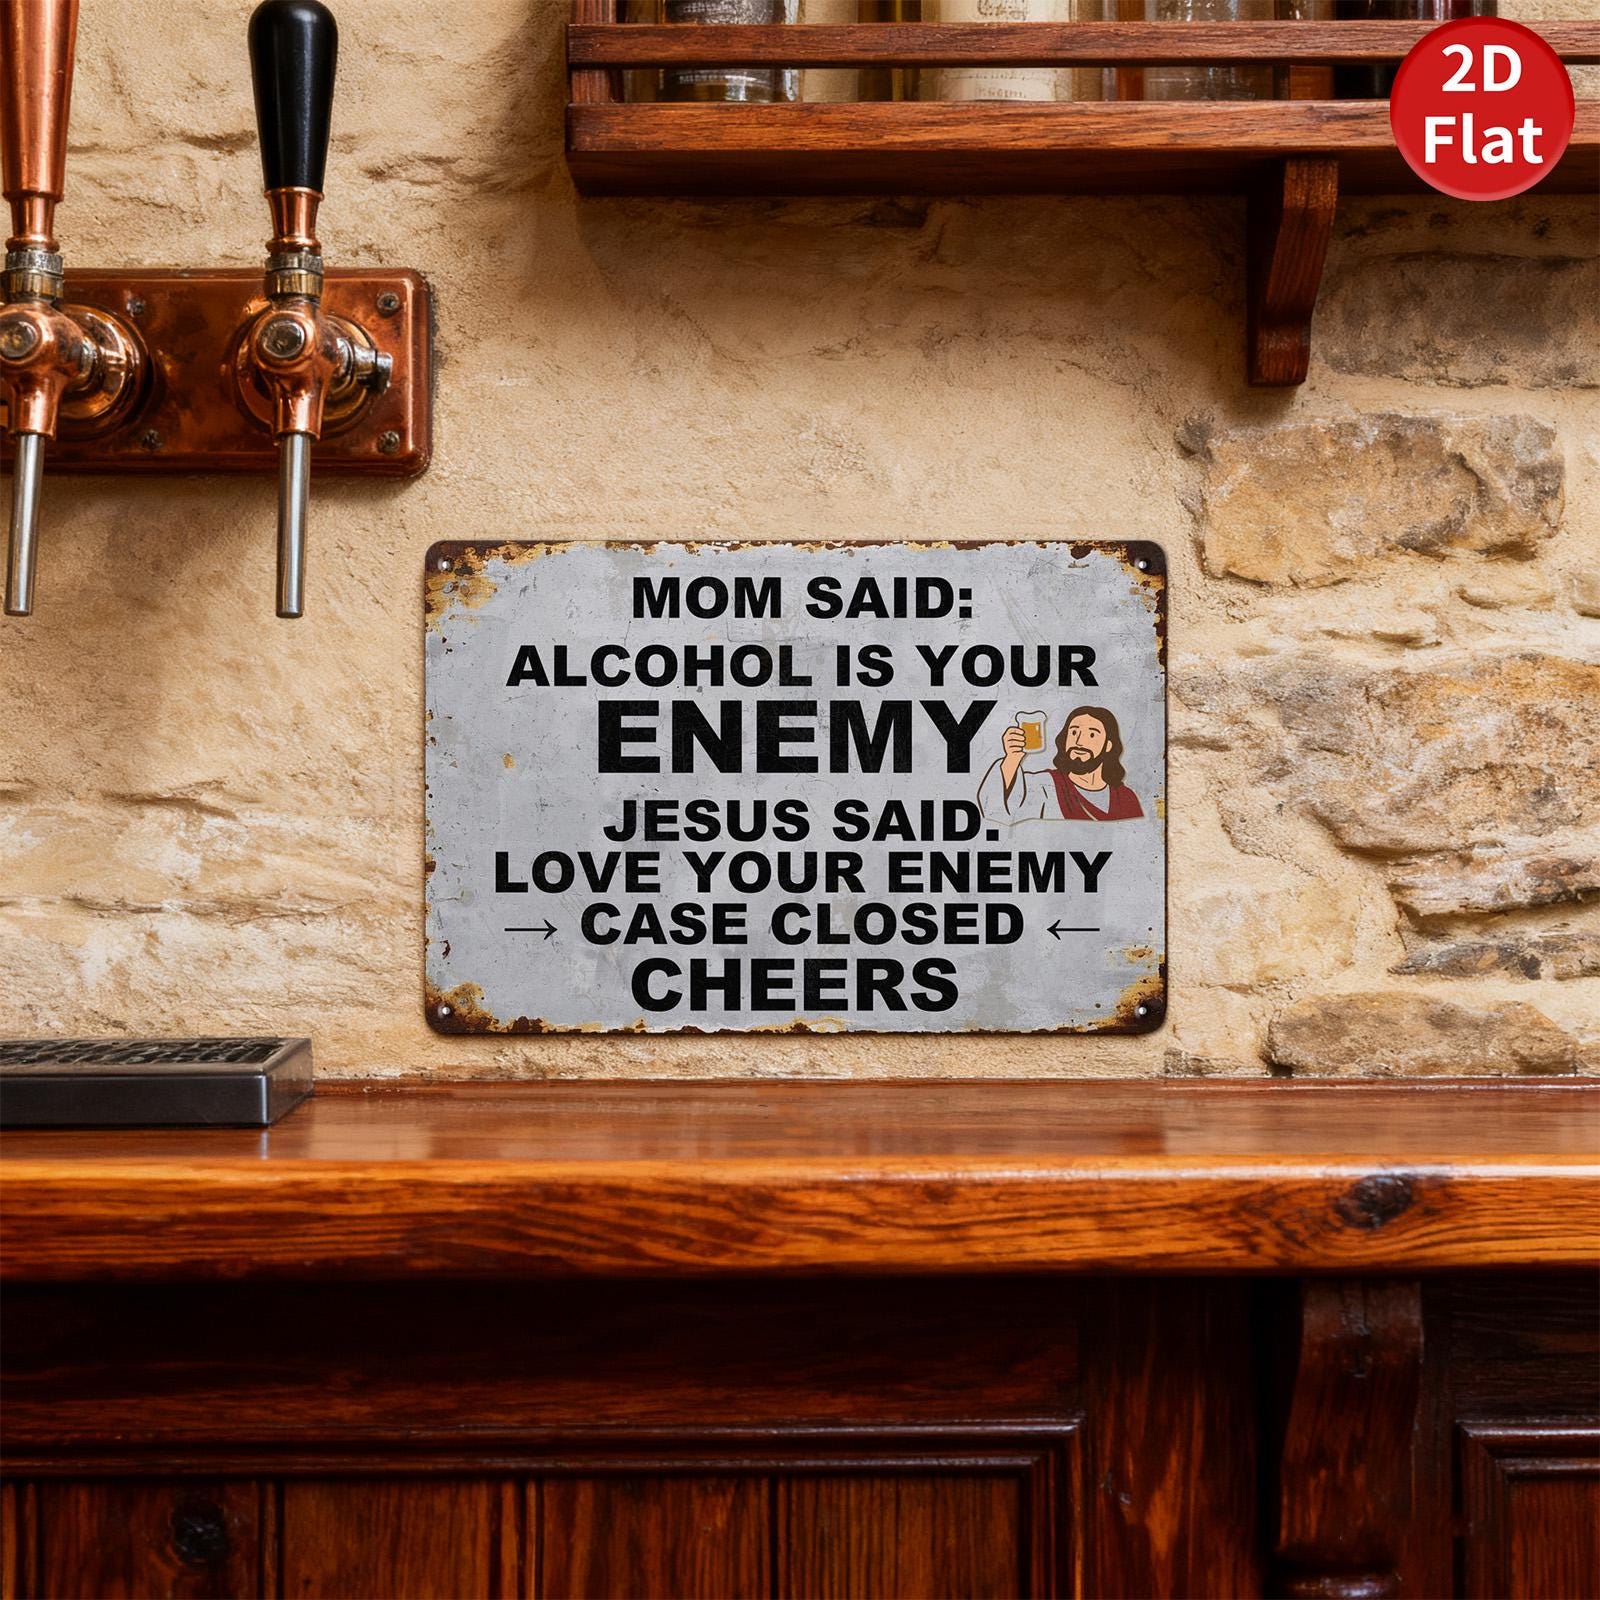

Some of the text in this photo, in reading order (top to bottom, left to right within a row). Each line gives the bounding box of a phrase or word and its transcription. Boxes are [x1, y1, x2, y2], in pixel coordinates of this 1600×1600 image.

[633, 577, 972, 618] MOM SAID:
[507, 645, 1098, 687] ALCOHOL IS YOUR
[598, 701, 998, 773] ENEMY
[603, 800, 999, 841] JESUS SAID.
[495, 851, 1112, 893] LOVE YOUR ENEMY
[582, 903, 1024, 945] CASE CLOSED
[632, 958, 959, 1011] CHEERS
